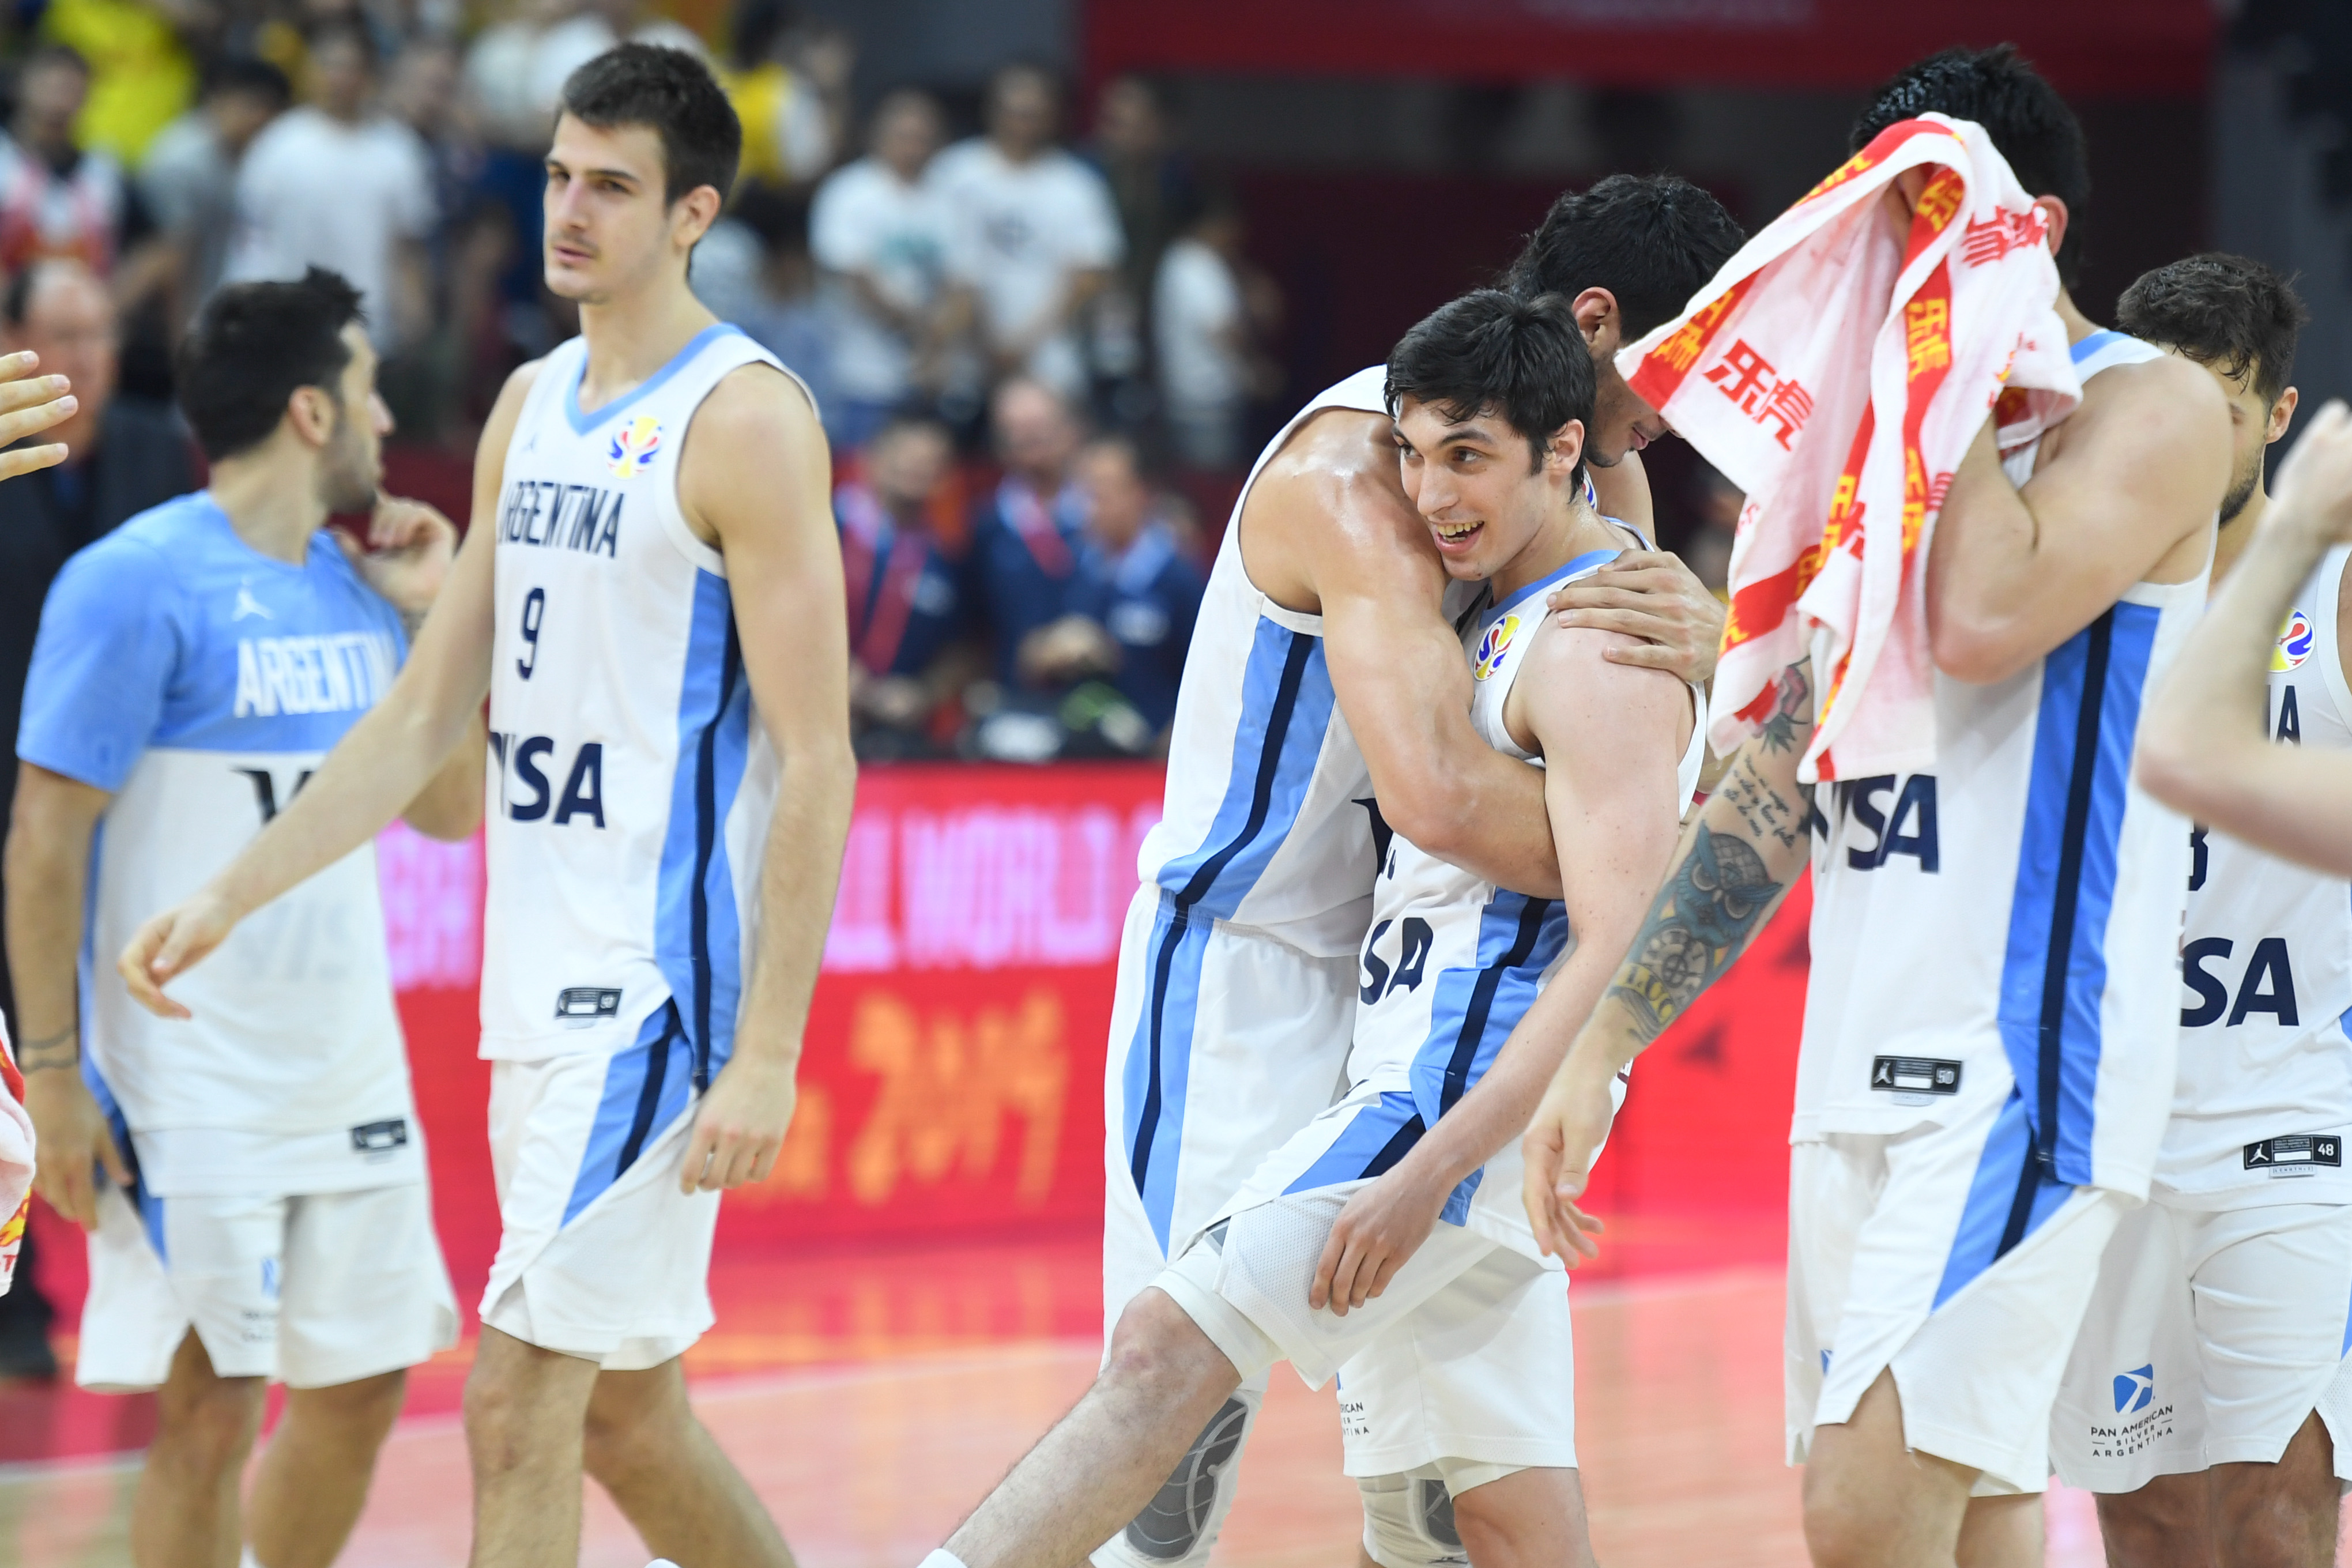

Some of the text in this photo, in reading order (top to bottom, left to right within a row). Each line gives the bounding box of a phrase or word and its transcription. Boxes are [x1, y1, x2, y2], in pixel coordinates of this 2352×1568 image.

[516, 587, 545, 681] 9
[2317, 1143, 2334, 1156] 48
[2090, 1404, 2173, 1437] PAN AMERICAN
[2116, 1424, 2155, 1446] SILVER
[2092, 1427, 2173, 1457] ARGENTINA
